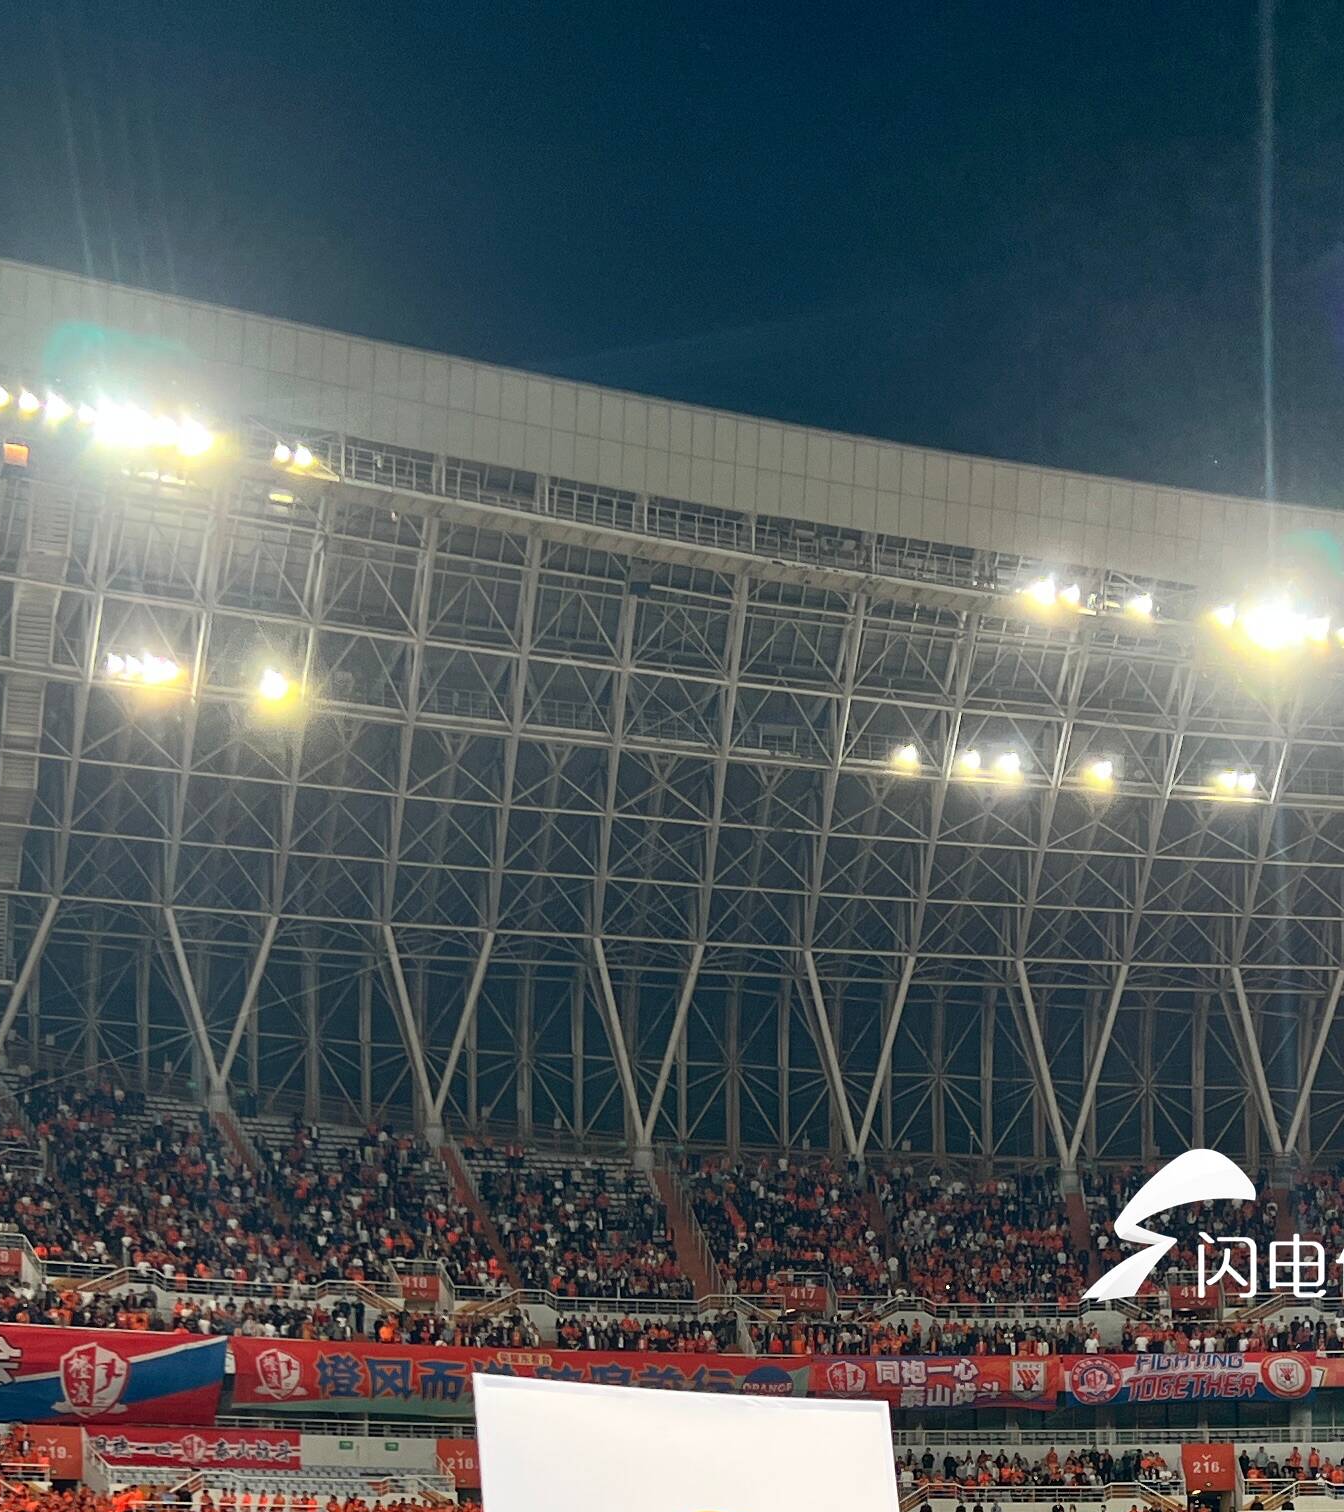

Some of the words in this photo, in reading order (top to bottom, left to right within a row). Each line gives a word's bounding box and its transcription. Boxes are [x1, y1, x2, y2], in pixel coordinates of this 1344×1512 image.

[790, 1286, 817, 1299] 417
[1180, 1286, 1206, 1298] 41
[875, 1358, 980, 1384] 同袍一心
[1135, 1352, 1246, 1374] FIGHTING
[314, 1350, 518, 1402] 橙风而
[1127, 1371, 1258, 1402] TOGETHER
[446, 1457, 475, 1470] 218
[1192, 1461, 1220, 1474] 216
